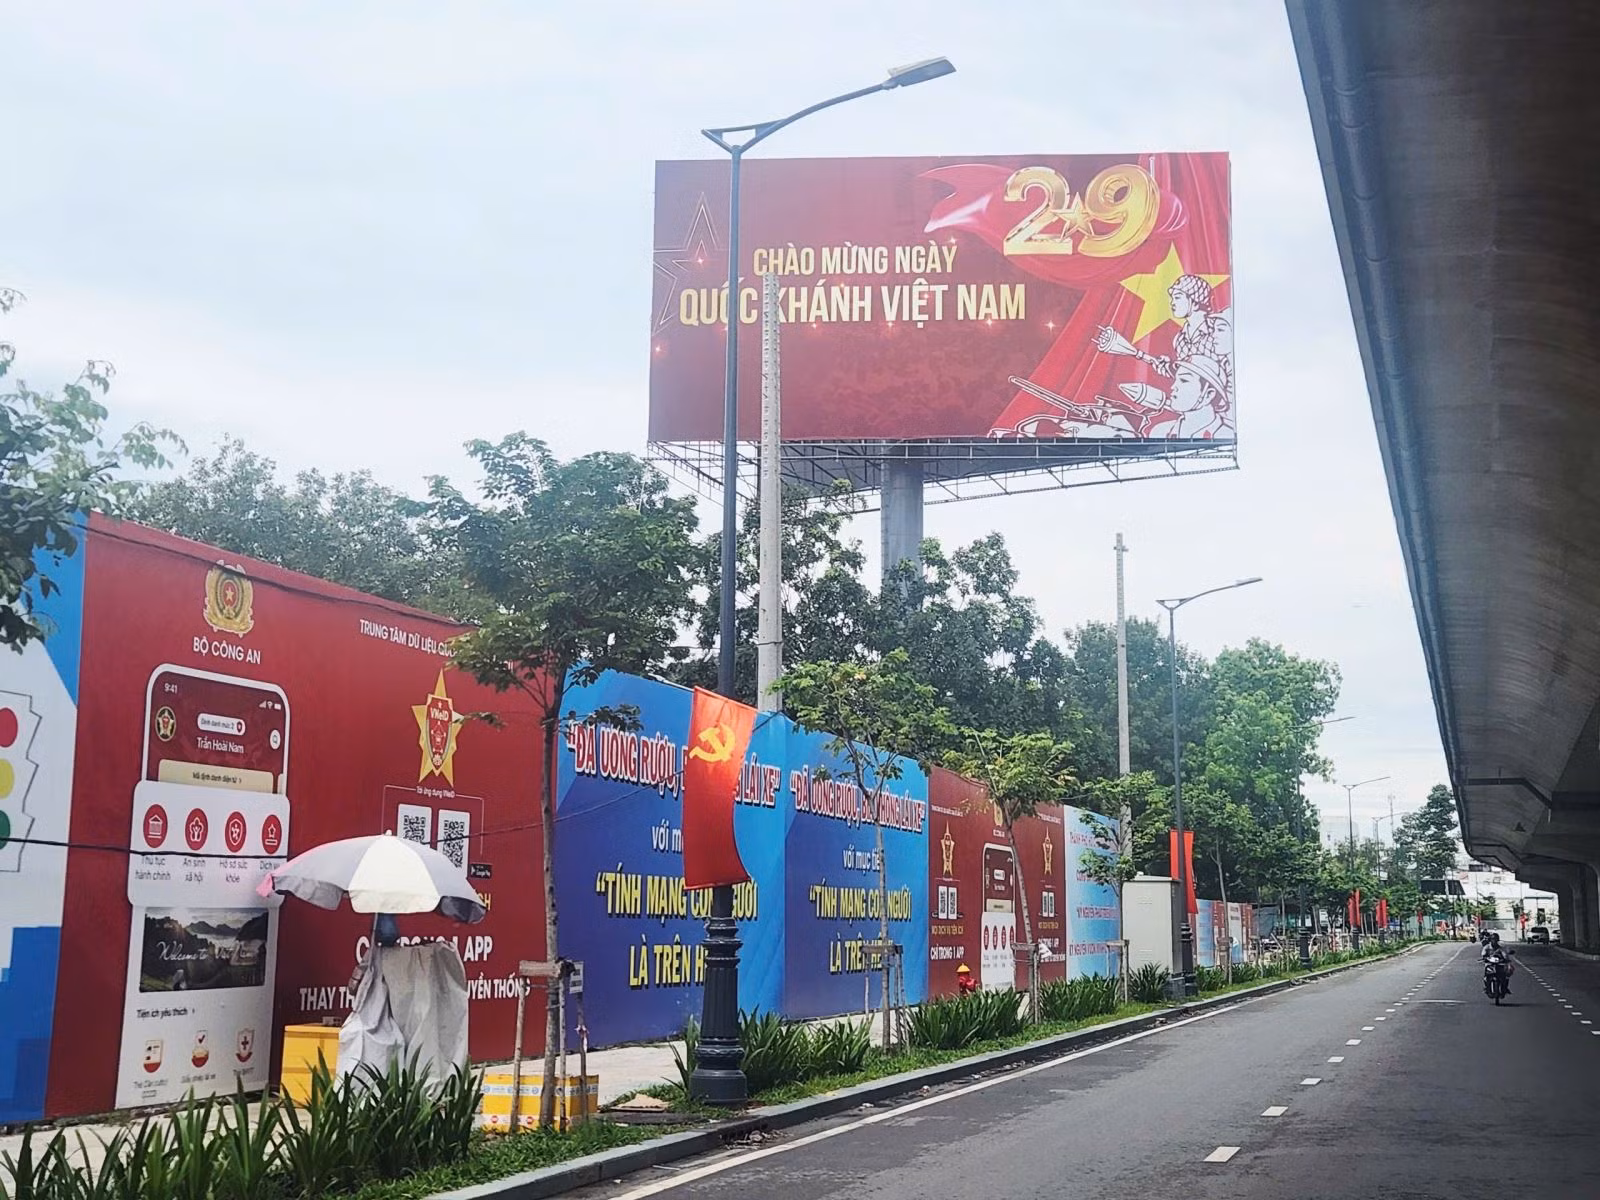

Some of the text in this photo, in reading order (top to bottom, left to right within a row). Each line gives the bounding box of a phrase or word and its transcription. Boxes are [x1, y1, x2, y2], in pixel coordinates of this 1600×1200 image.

[753, 240, 958, 276] CHÀO MỪNG NGÀY
[680, 277, 758, 327] QUỐC
[881, 277, 949, 329] VIỆT
[957, 284, 1026, 320] NAM
[193, 636, 261, 665] BỘ CÔNG AN
[359, 619, 390, 640] TRUNG
[389, 626, 407, 646] TÂM
[408, 633, 420, 649] DỮ
[421, 637, 437, 655] LIỆU
[164, 683, 178, 694] 9:41
[197, 735, 245, 754] Trần Hoài Nam
[640, 731, 679, 798] RƯỢU,
[743, 752, 761, 806] LÁI
[652, 820, 669, 851] với
[843, 844, 855, 869] với
[856, 851, 871, 875] mục
[596, 862, 641, 915] “TÍNH
[646, 875, 687, 924] MẠNG
[840, 887, 867, 925] MẠNG
[868, 888, 881, 919] CO
[887, 883, 913, 920] NGƯỜI
[463, 936, 493, 962] APP
[629, 934, 649, 987] LÀ
[653, 934, 691, 985] TRÊN
[830, 932, 842, 972] LÀ
[299, 986, 336, 1011] THAY
[494, 972, 531, 999] THỐNG
